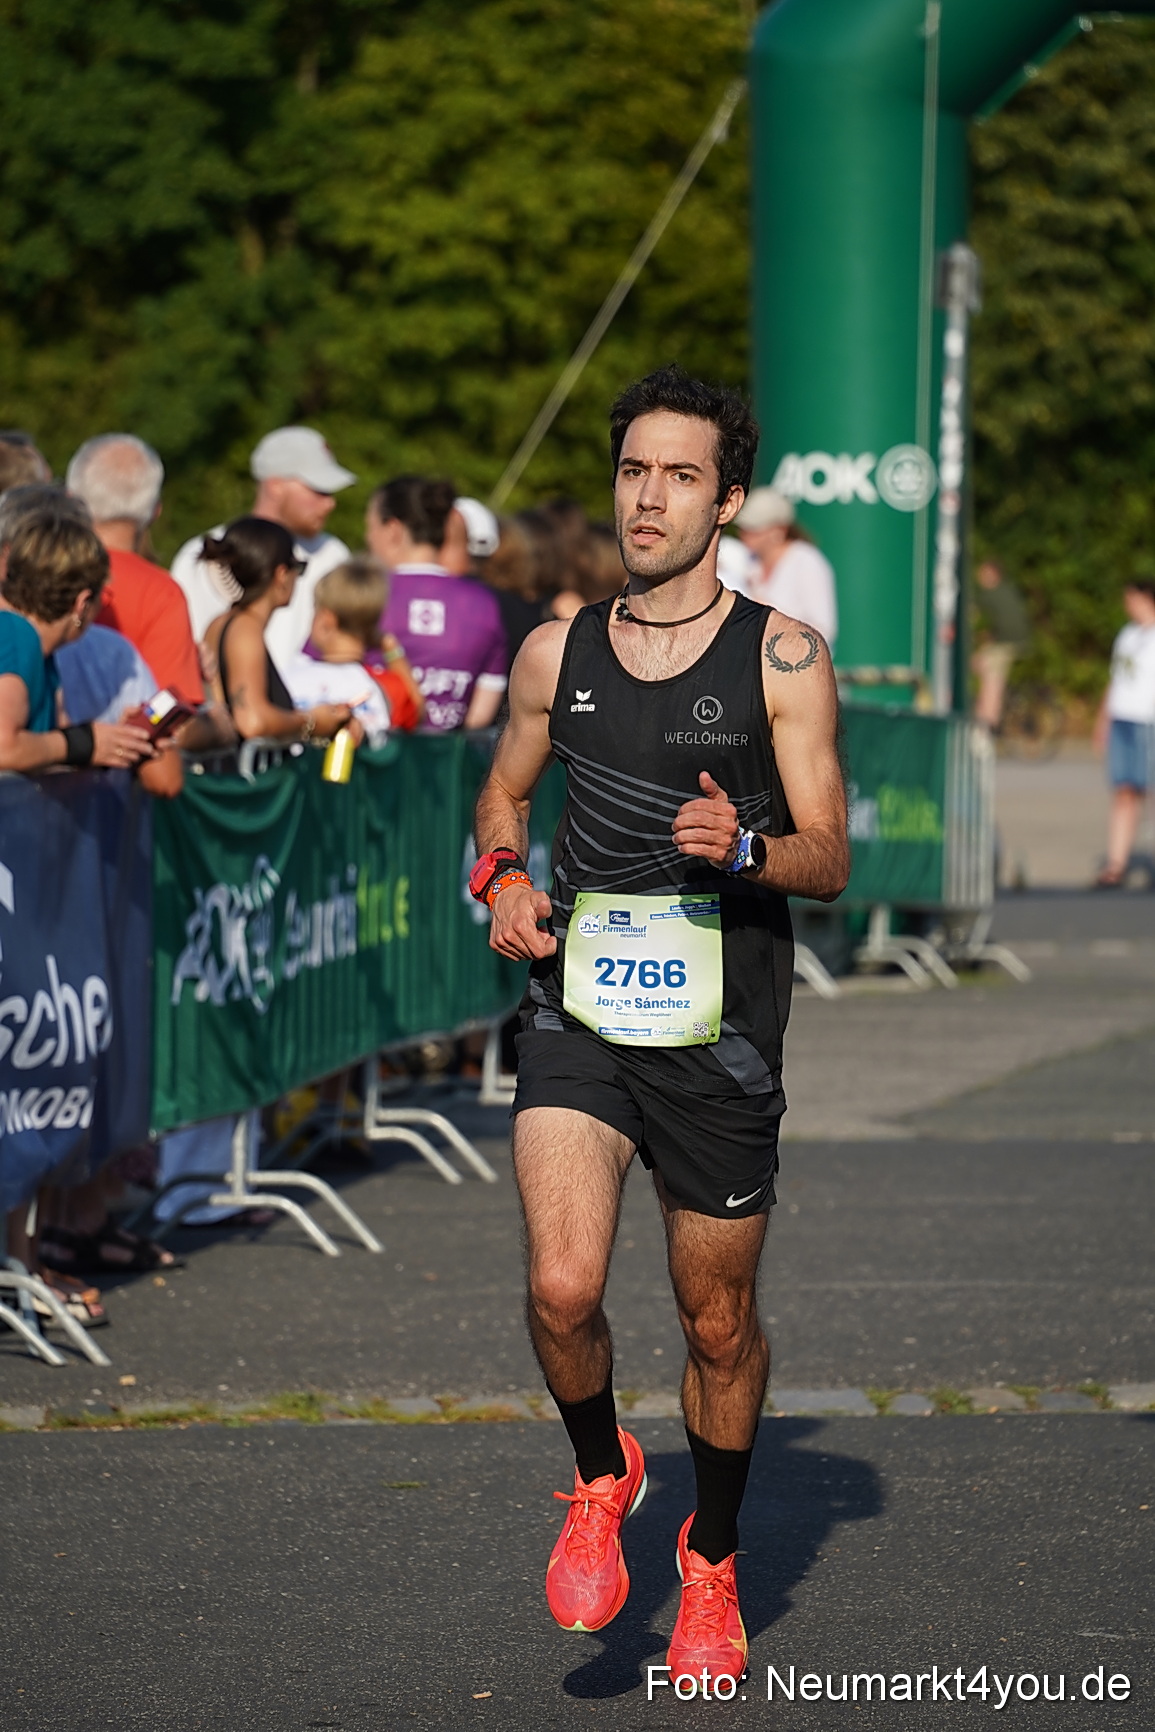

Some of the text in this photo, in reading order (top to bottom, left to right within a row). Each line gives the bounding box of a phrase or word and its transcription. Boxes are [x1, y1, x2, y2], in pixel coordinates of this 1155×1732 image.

[770, 451, 880, 505] AOK
[570, 703, 596, 713] erima
[664, 731, 749, 746] WEGLÖHNER
[602, 924, 647, 933] Firmenlauf
[594, 957, 687, 988] 2766
[595, 995, 691, 1010] Jorge Sánchez
